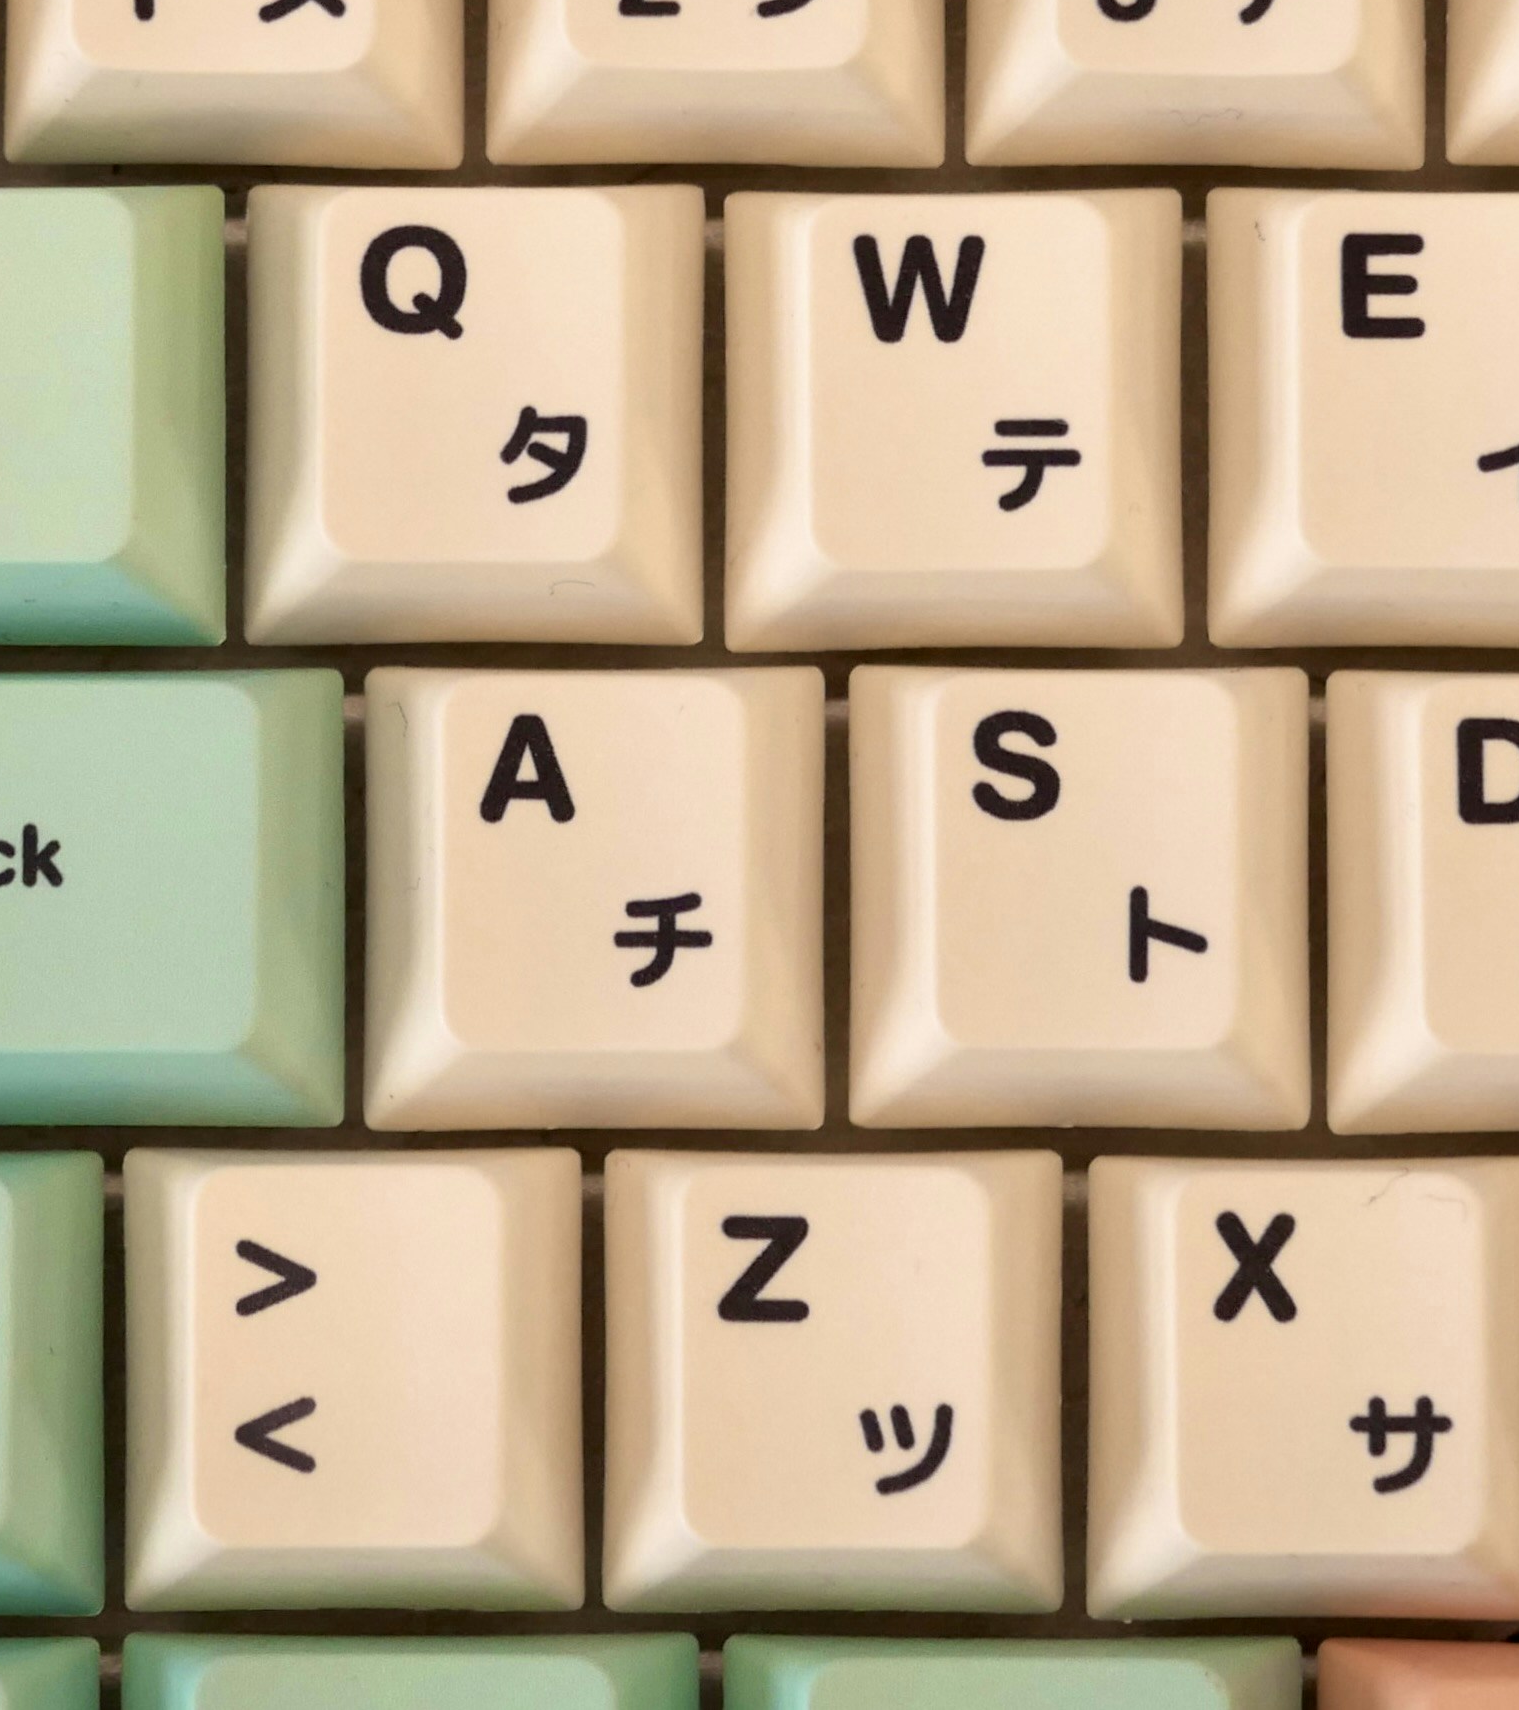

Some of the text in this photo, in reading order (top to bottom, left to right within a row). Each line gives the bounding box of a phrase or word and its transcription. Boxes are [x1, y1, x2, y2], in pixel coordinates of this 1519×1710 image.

[359, 224, 468, 341] Q
[852, 233, 986, 345] W
[1340, 232, 1427, 340] E
[499, 405, 588, 505] タ
[980, 418, 1082, 513] テ
[478, 713, 577, 825] A
[971, 709, 1062, 822] S
[612, 891, 714, 989] チ
[1128, 885, 1209, 984] ト
[234, 1239, 318, 1317] >
[716, 1214, 811, 1324] Z
[1212, 1210, 1298, 1324] X
[233, 1396, 317, 1474] <
[858, 1402, 954, 1496] ツ
[1348, 1395, 1453, 1495] サ
